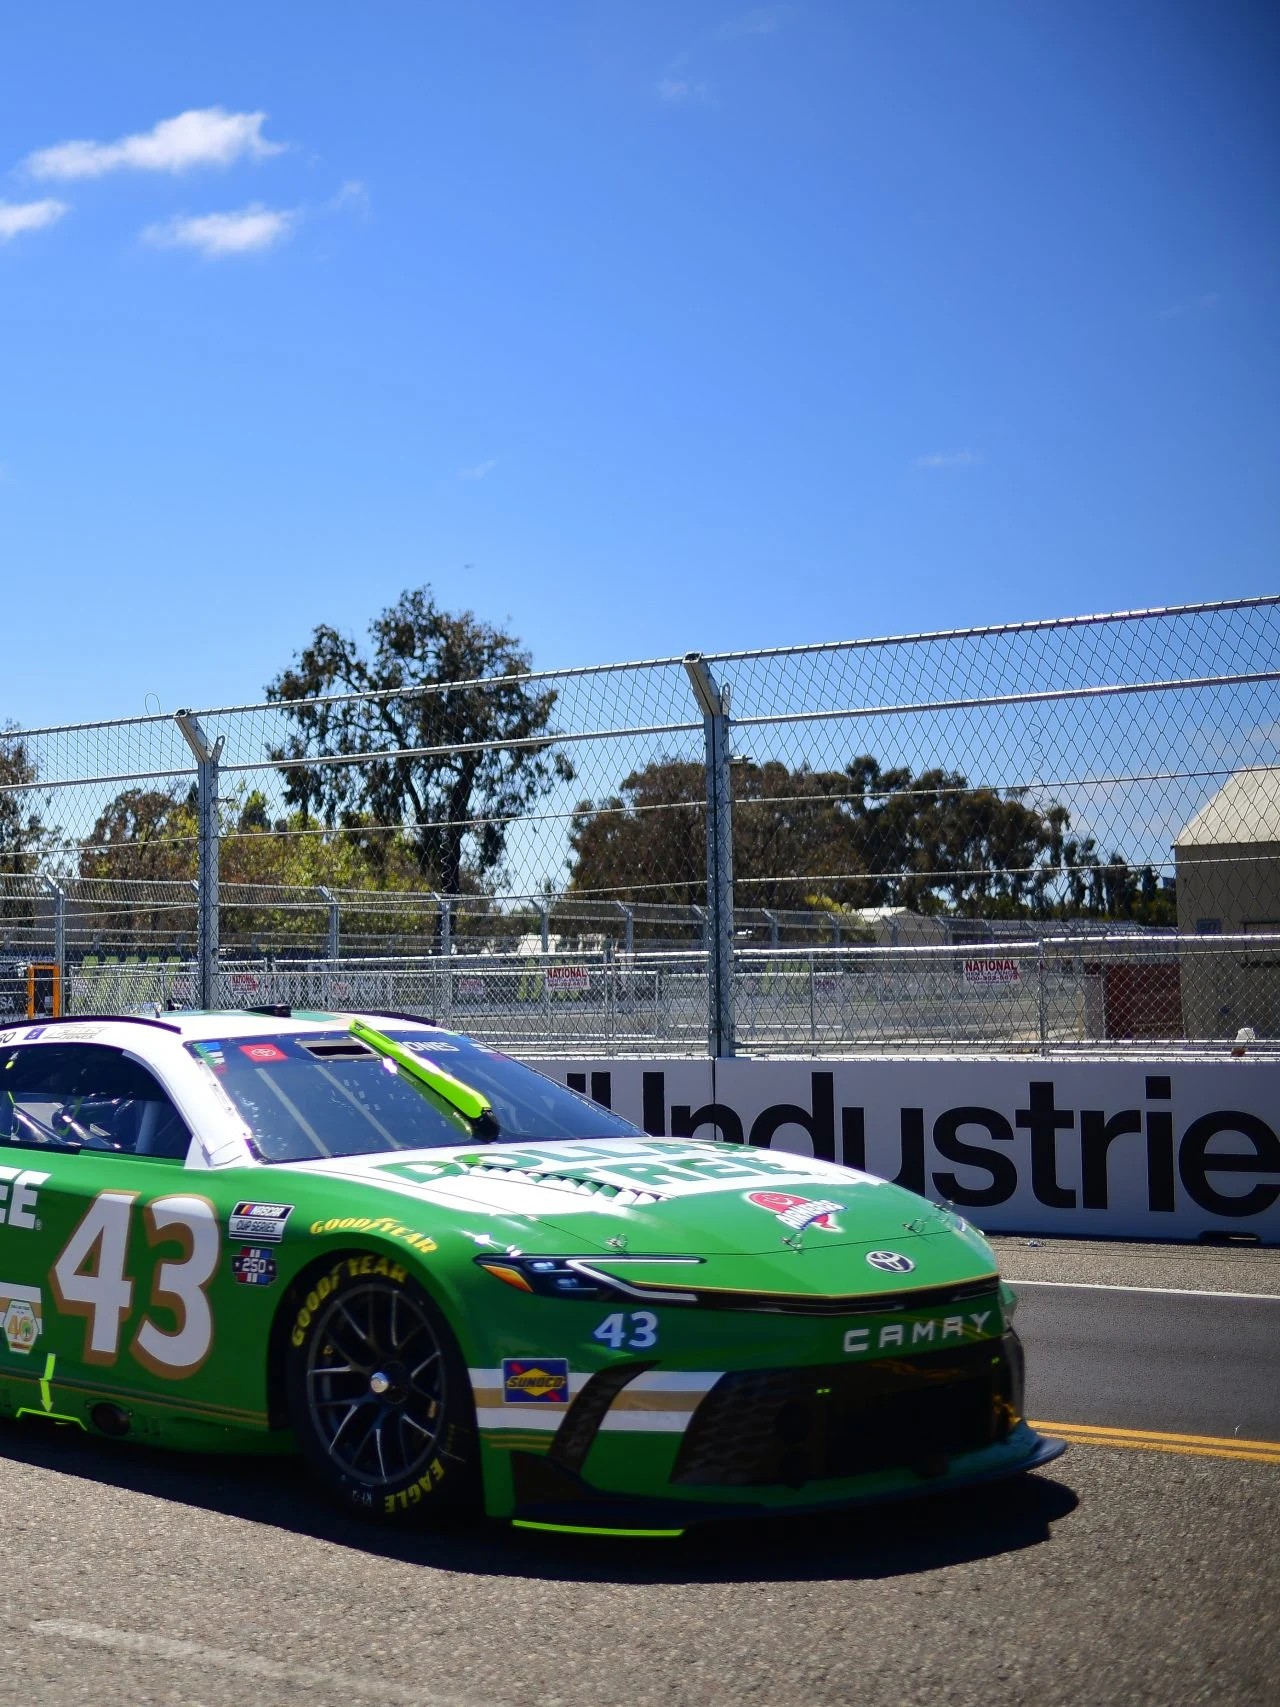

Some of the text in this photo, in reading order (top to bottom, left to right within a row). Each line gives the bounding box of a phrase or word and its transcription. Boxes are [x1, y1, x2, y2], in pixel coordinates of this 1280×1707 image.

[547, 967, 588, 978] NATIONAL
[965, 959, 1018, 971] NATIONAL
[253, 1205, 285, 1217] NASCAR
[236, 1220, 278, 1233] CUP SERIES
[310, 1216, 438, 1253] GOODYEAR
[242, 1258, 266, 1273] 250
[48, 1190, 220, 1380] 43
[291, 1255, 409, 1348] GOODYEAR
[593, 1311, 659, 1348] 43
[843, 1310, 993, 1353] CAMRY
[507, 1376, 566, 1388] SUNOCO
[384, 1457, 446, 1513] EAGLE
